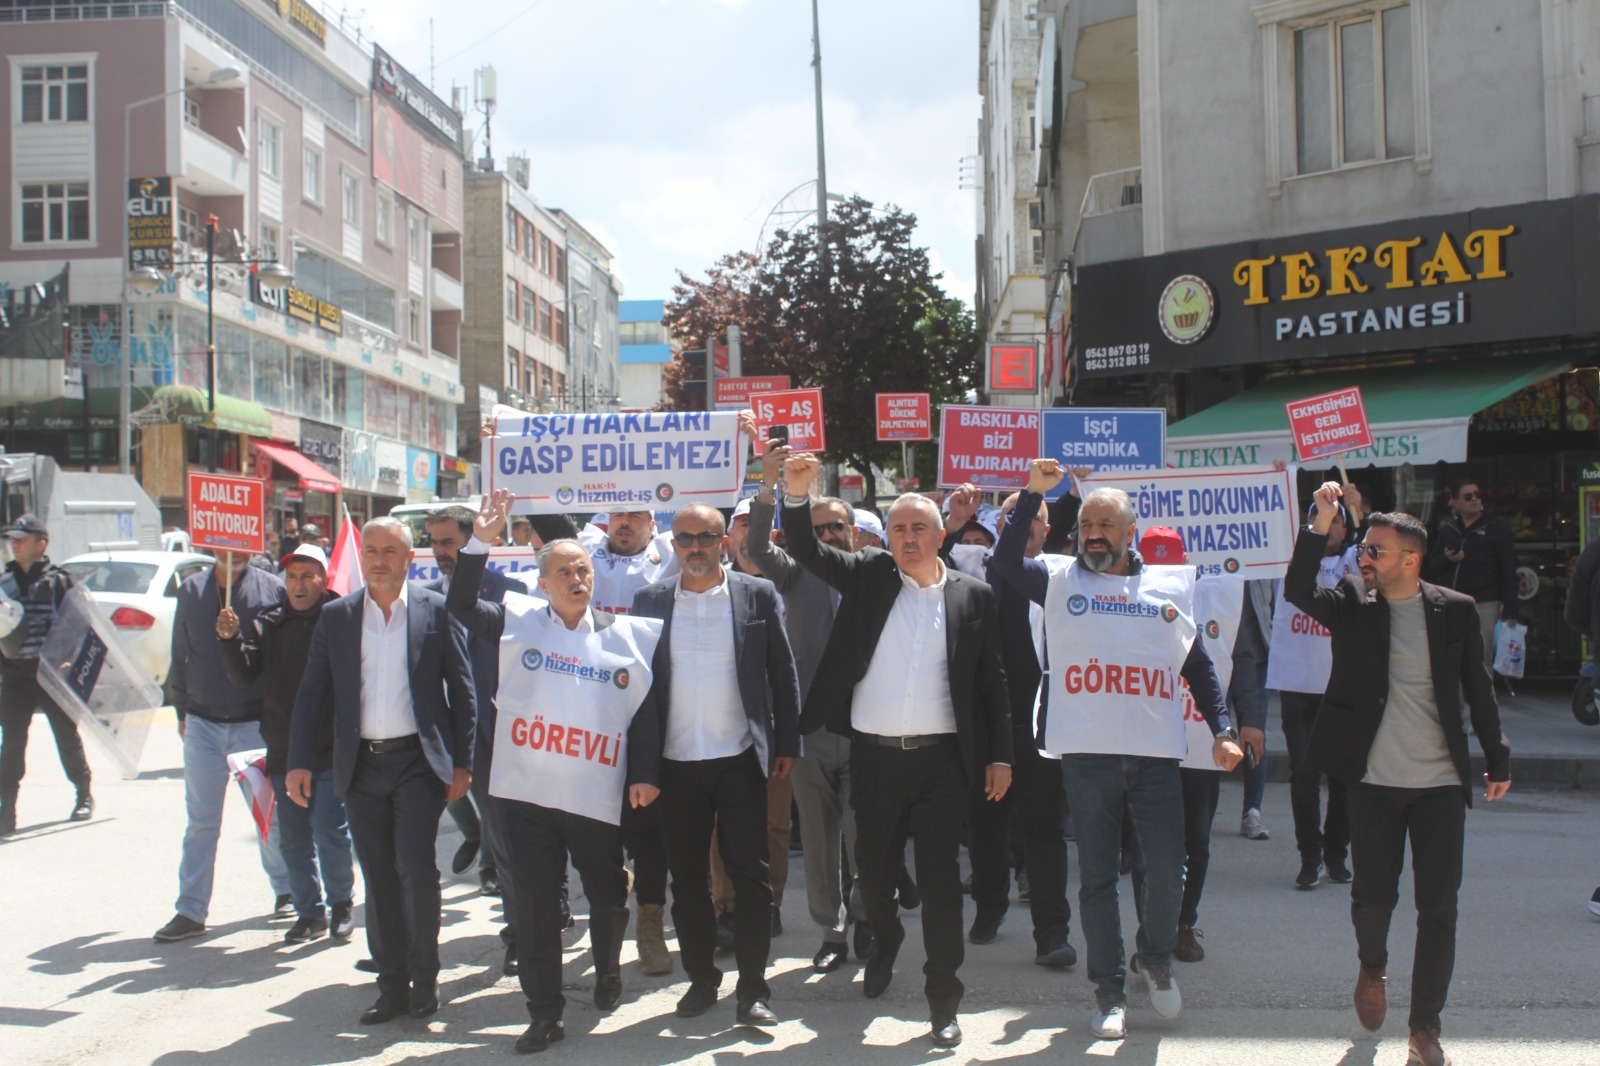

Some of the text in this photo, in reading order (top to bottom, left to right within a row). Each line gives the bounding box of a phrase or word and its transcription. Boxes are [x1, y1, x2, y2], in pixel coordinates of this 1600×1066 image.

[1233, 224, 1515, 306] TEKTAT
[1085, 343, 1150, 358] 0543 867 03 19
[1000, 353, 1026, 384] E
[1085, 354, 1150, 371] 0543 312 80 15
[757, 400, 774, 422] İŞ
[790, 400, 813, 419] AŞ
[889, 407, 917, 418] DÖKENE
[1292, 393, 1358, 420] EKMEĞİMİZİ
[583, 411, 711, 435] HAKLARI
[758, 421, 816, 441] EMEK
[880, 419, 928, 429] ZULMETMEYİN
[960, 412, 1039, 429] BASKILAR
[1084, 416, 1118, 436] İŞÇİ
[1314, 411, 1342, 429] GERİ
[983, 431, 1013, 449] BİZİ
[1301, 422, 1362, 446] İSTİYORUZ
[500, 435, 731, 475] GASP EDİLEMEZ!
[1062, 438, 1139, 457] SENDİKA
[1174, 444, 1261, 468] TEKTAT
[950, 455, 1034, 472] YILDIRAMA
[200, 482, 251, 506] ADALET
[1190, 484, 1284, 516] DOKUNMA
[193, 504, 259, 536] İSTİYORUZ
[1065, 658, 1175, 701] GÖREVLİ
[511, 715, 622, 768] GÖREVLİ
